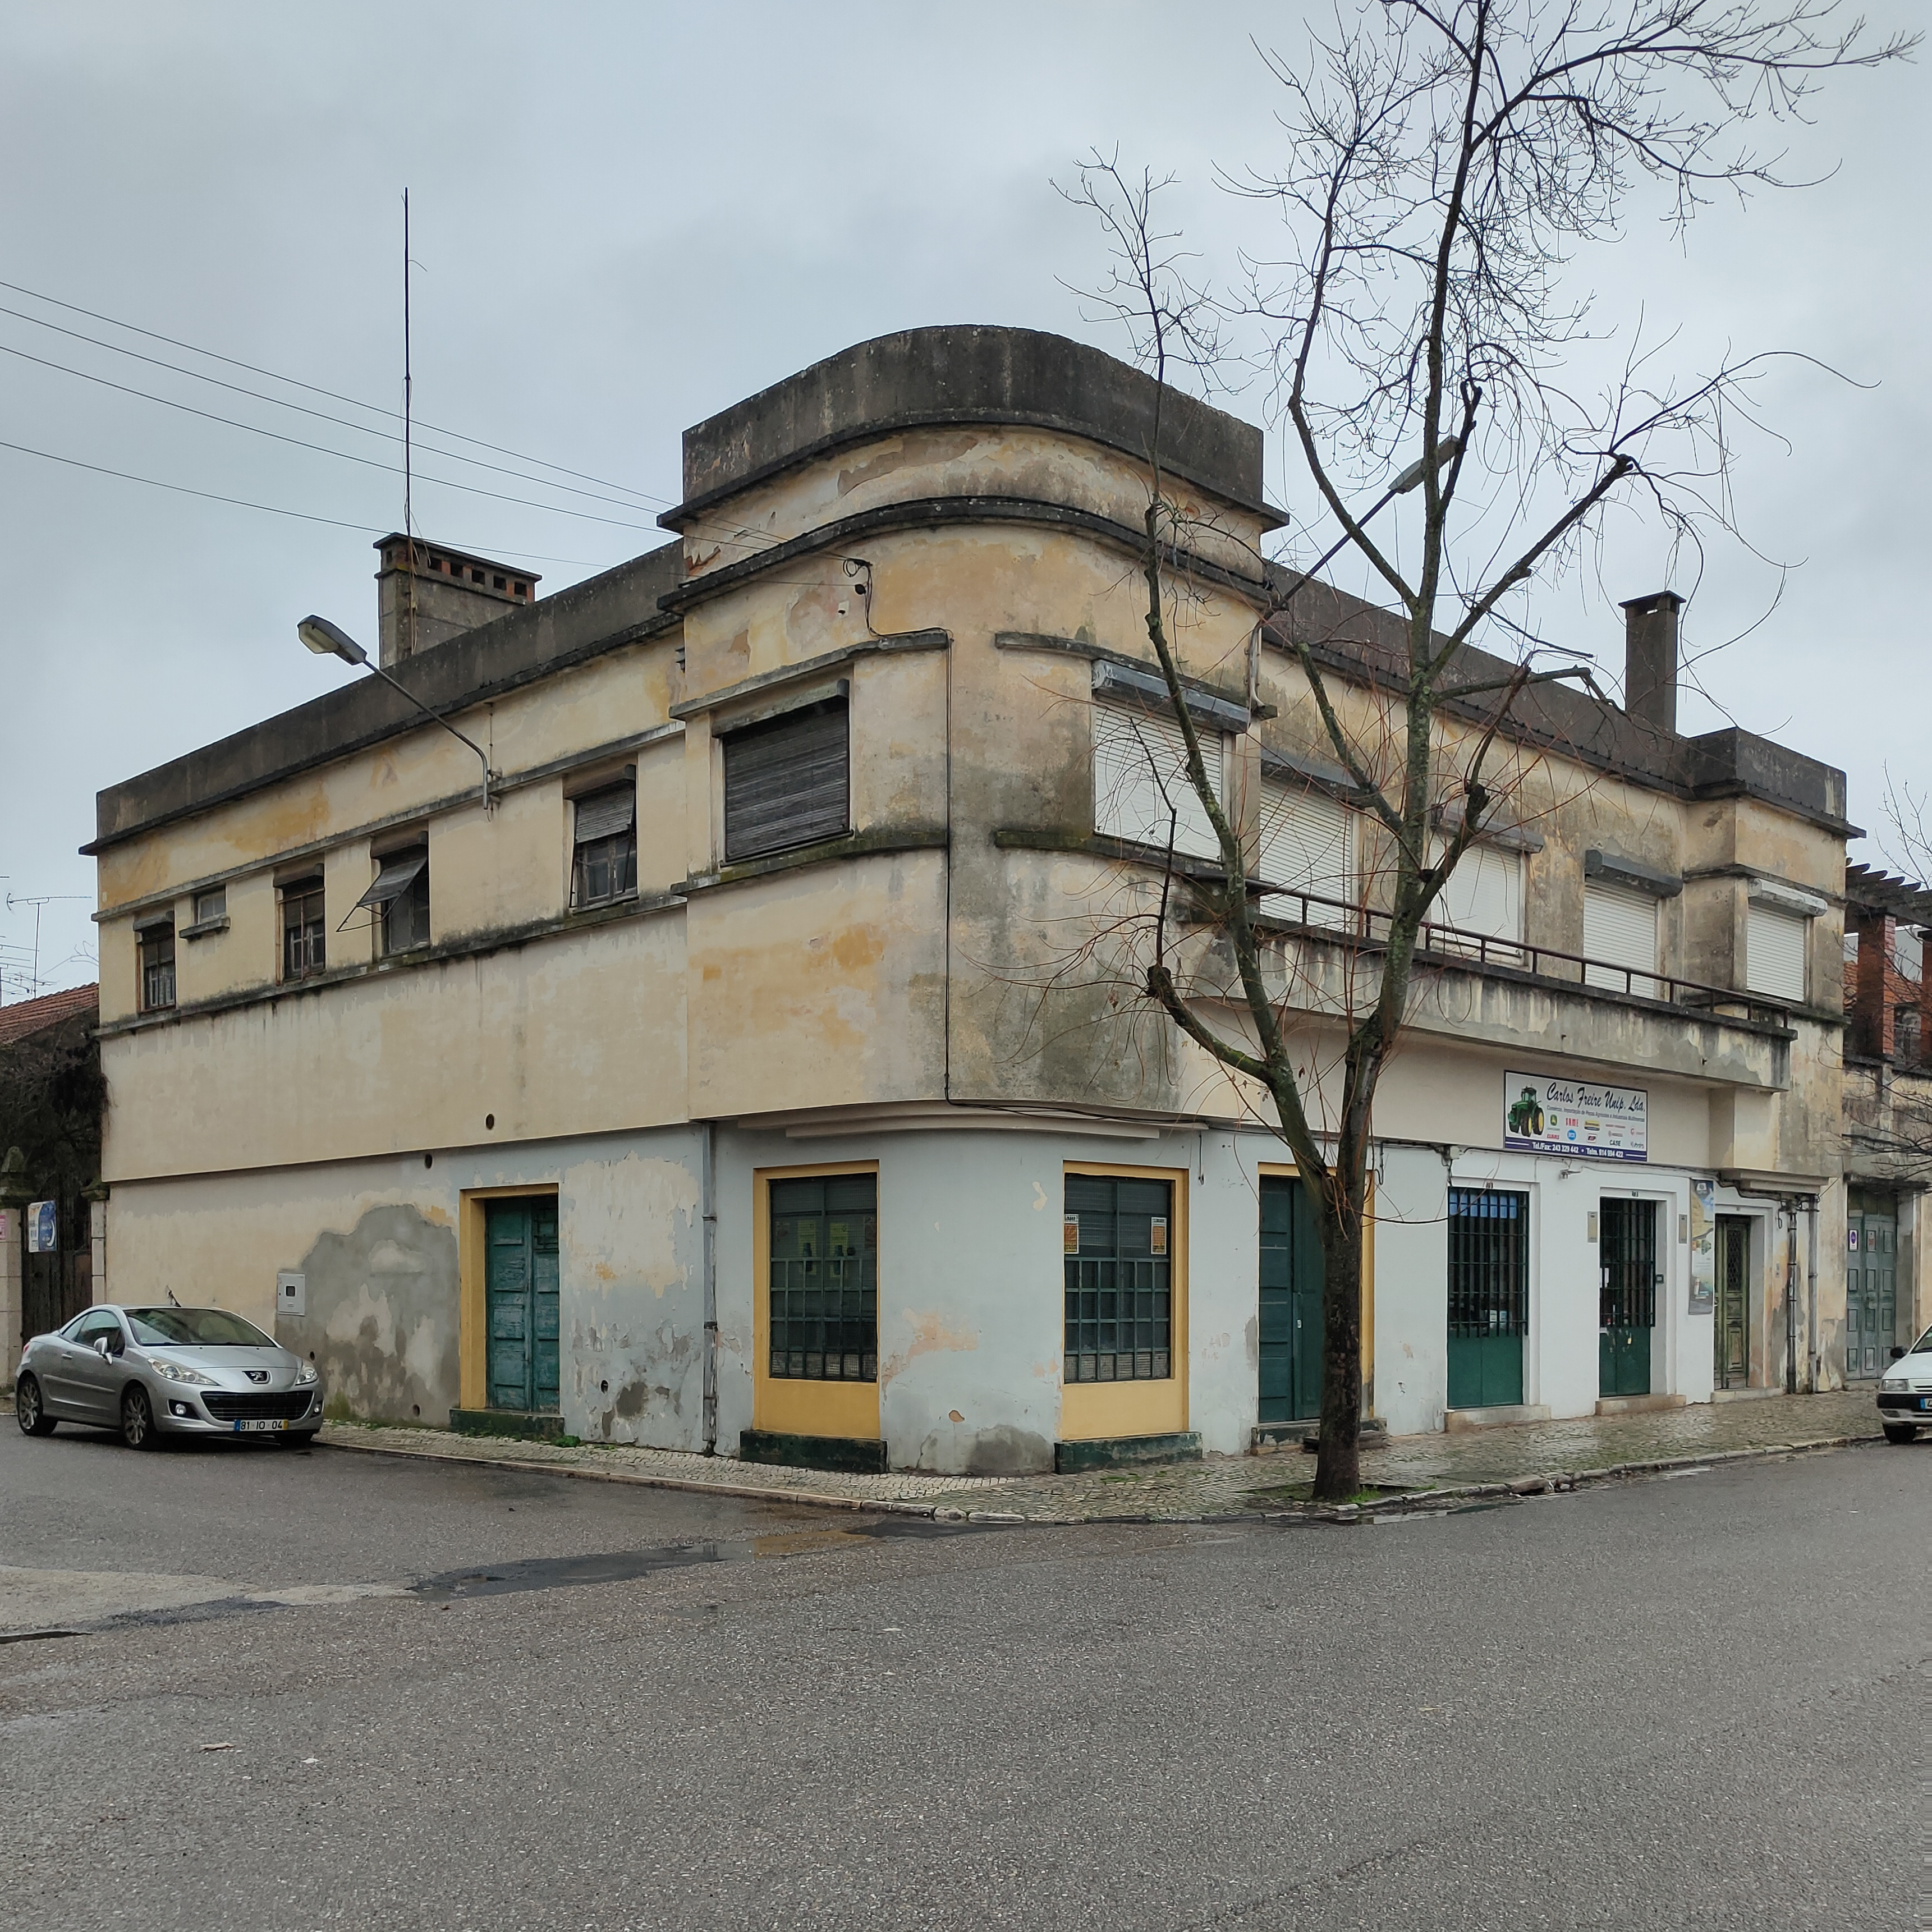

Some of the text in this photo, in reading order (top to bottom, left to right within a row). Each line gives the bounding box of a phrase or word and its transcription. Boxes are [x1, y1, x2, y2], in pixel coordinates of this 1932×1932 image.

[1546, 1081, 1645, 1113] Carlos Freire Unip. Lda.
[241, 1421, 250, 1430] 81
[272, 1420, 282, 1429] 04
